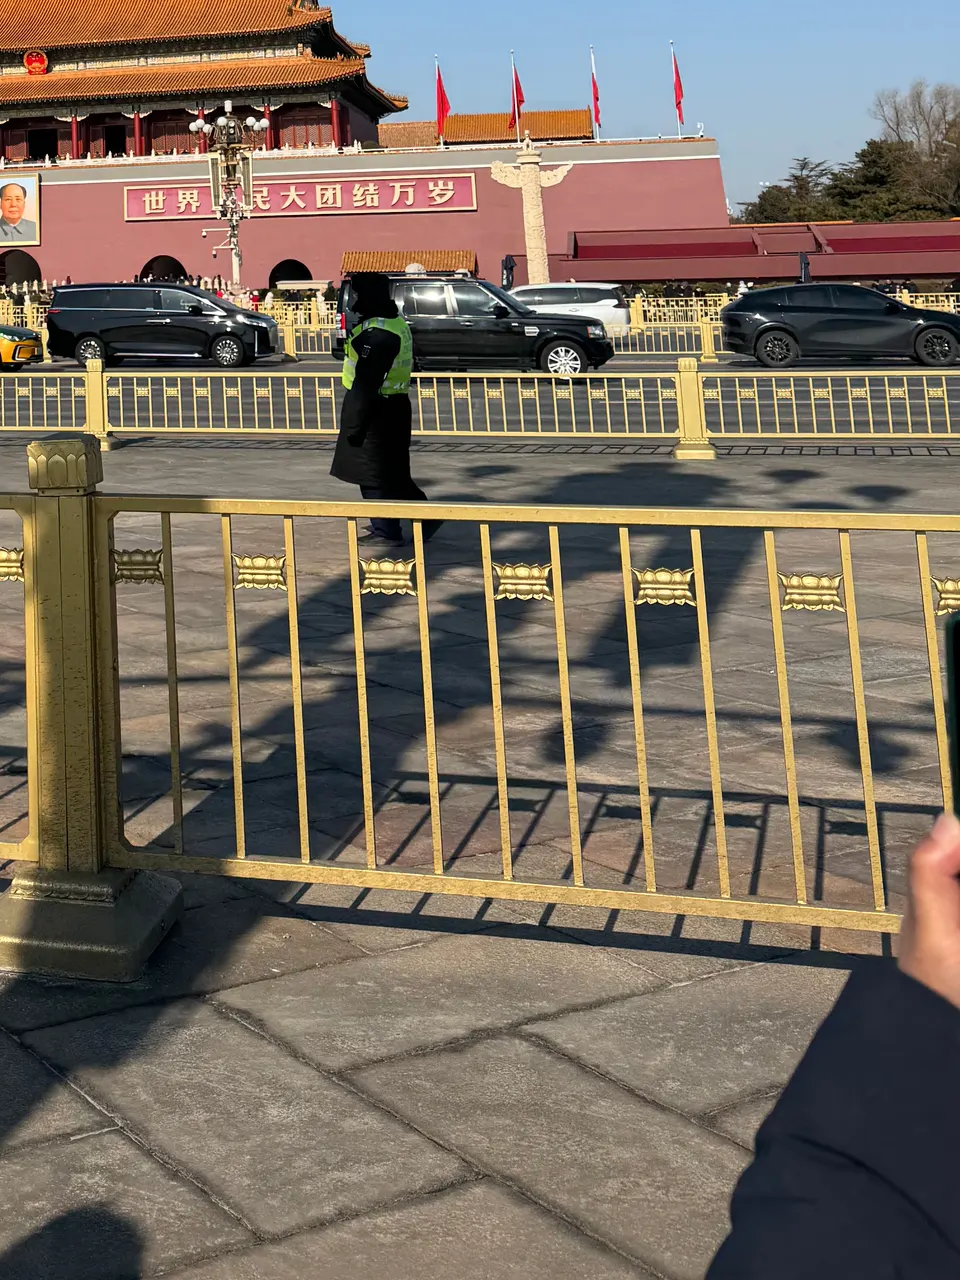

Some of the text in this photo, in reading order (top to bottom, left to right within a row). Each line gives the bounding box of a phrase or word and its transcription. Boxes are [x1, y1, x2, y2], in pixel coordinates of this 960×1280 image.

[142, 180, 456, 214] 世界民大团结万岁
